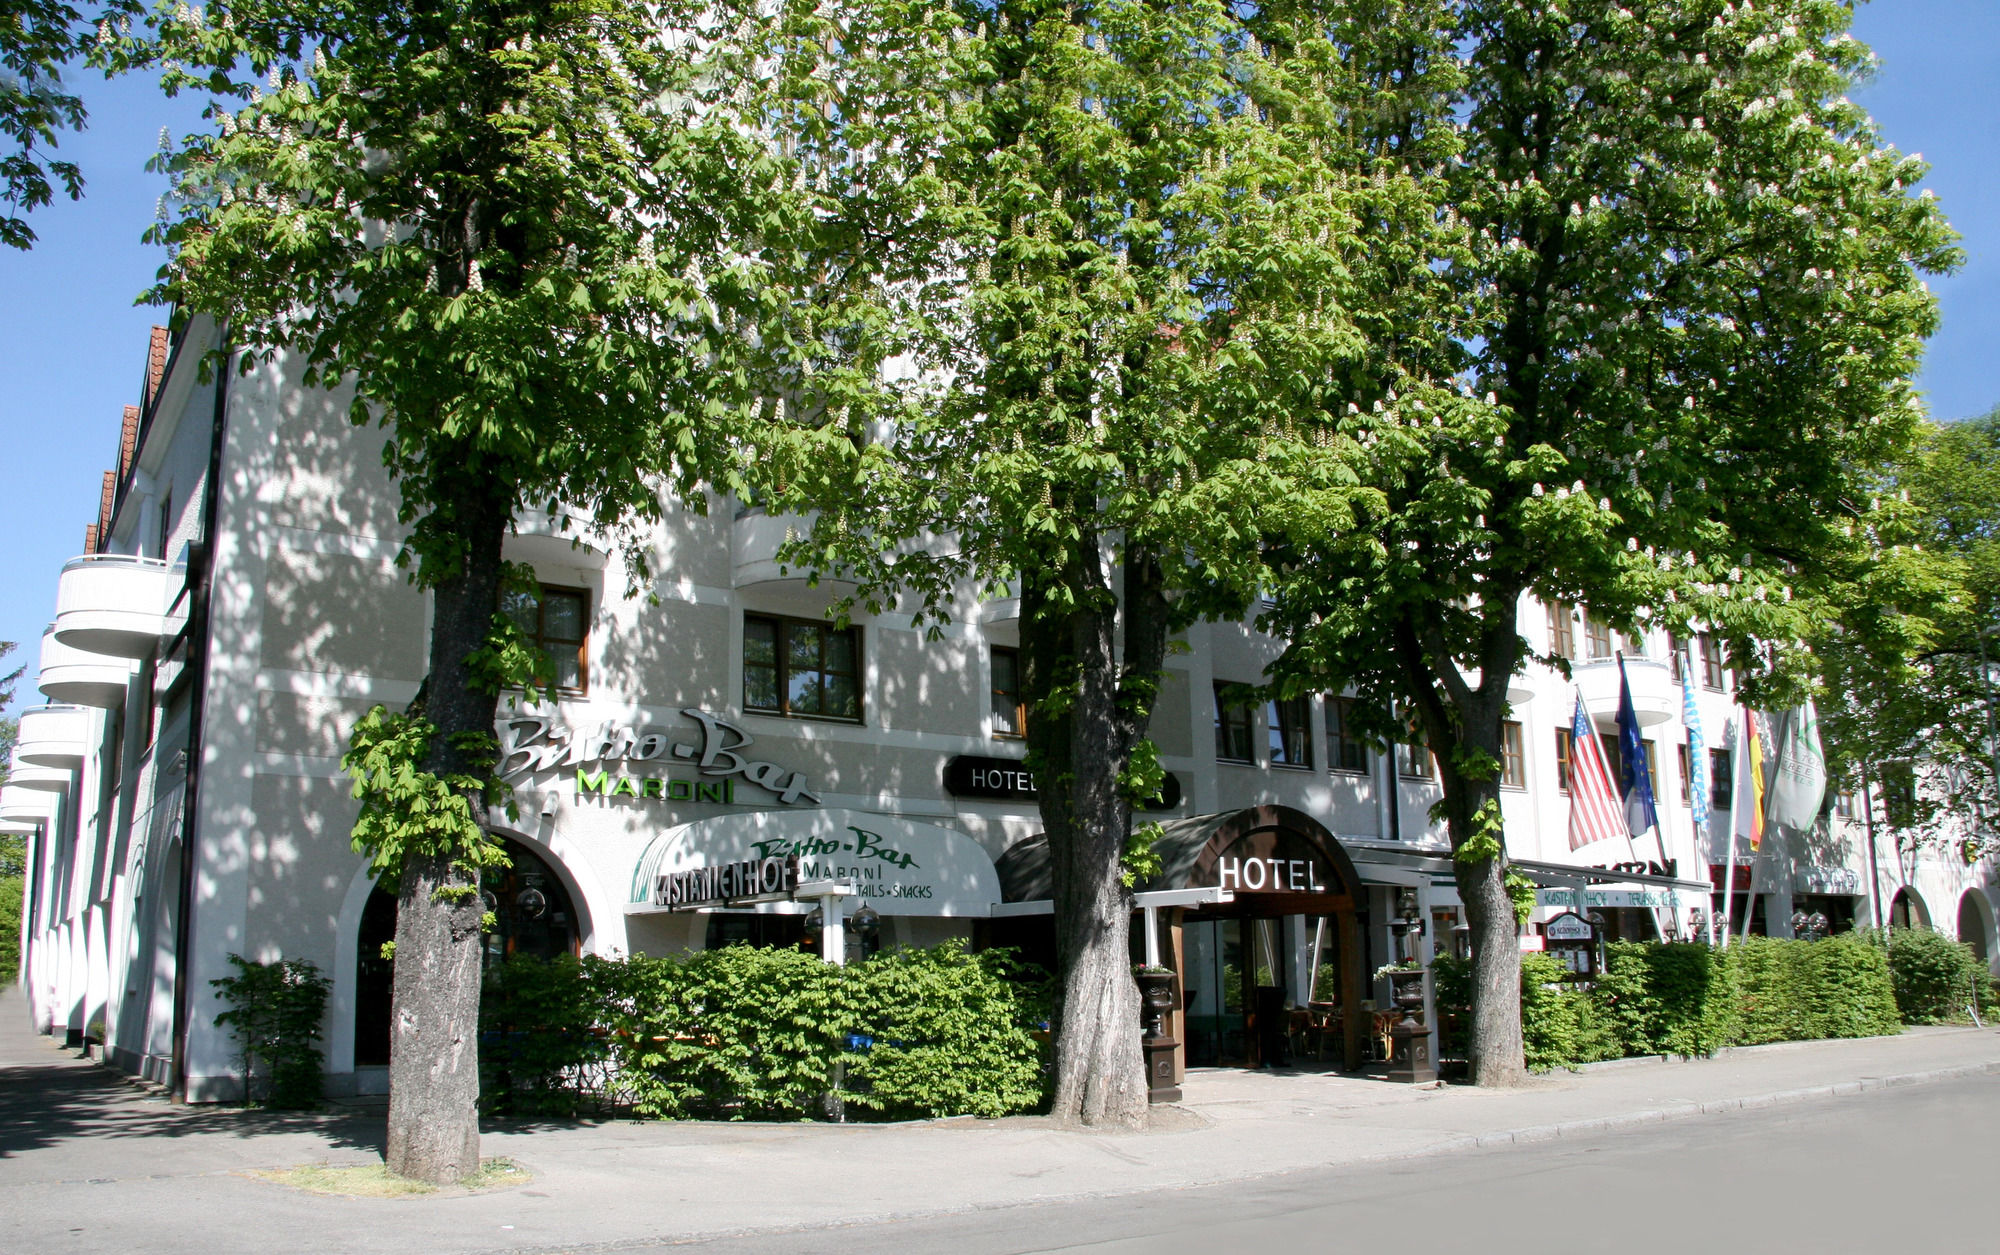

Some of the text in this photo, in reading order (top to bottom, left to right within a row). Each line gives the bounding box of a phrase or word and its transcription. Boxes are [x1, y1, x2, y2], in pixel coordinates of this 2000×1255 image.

[972, 768, 1037, 792] HOTEL
[654, 856, 791, 905] KASTANIENHOF
[1219, 856, 1325, 891] HOTEL
[1544, 891, 1608, 906] KASTANNHOF
